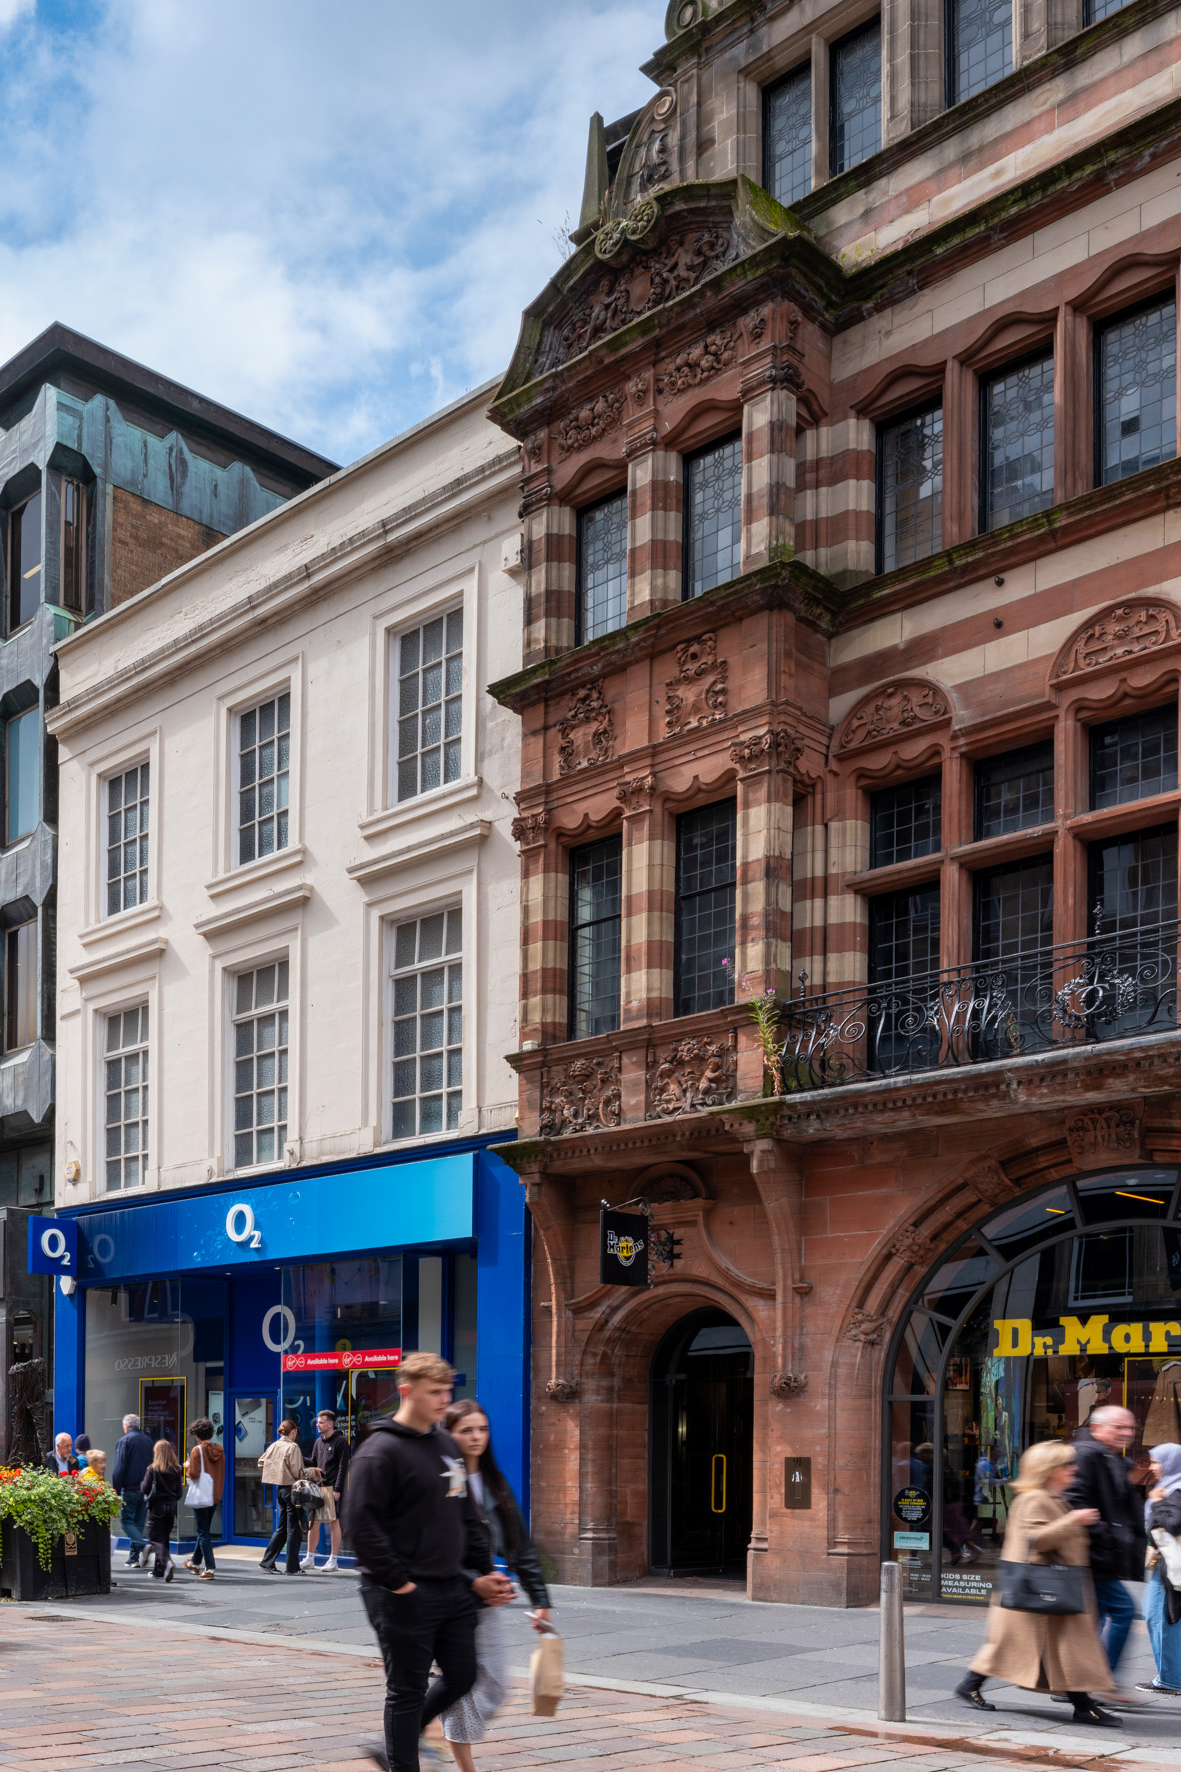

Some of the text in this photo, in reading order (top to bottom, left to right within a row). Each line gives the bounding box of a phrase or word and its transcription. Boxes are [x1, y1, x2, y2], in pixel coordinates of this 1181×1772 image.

[226, 1203, 262, 1248] O2
[40, 1228, 71, 1266] O2
[607, 1238, 645, 1254] Martens
[993, 1318, 1054, 1357] Dr.
[307, 1357, 328, 1365] Available
